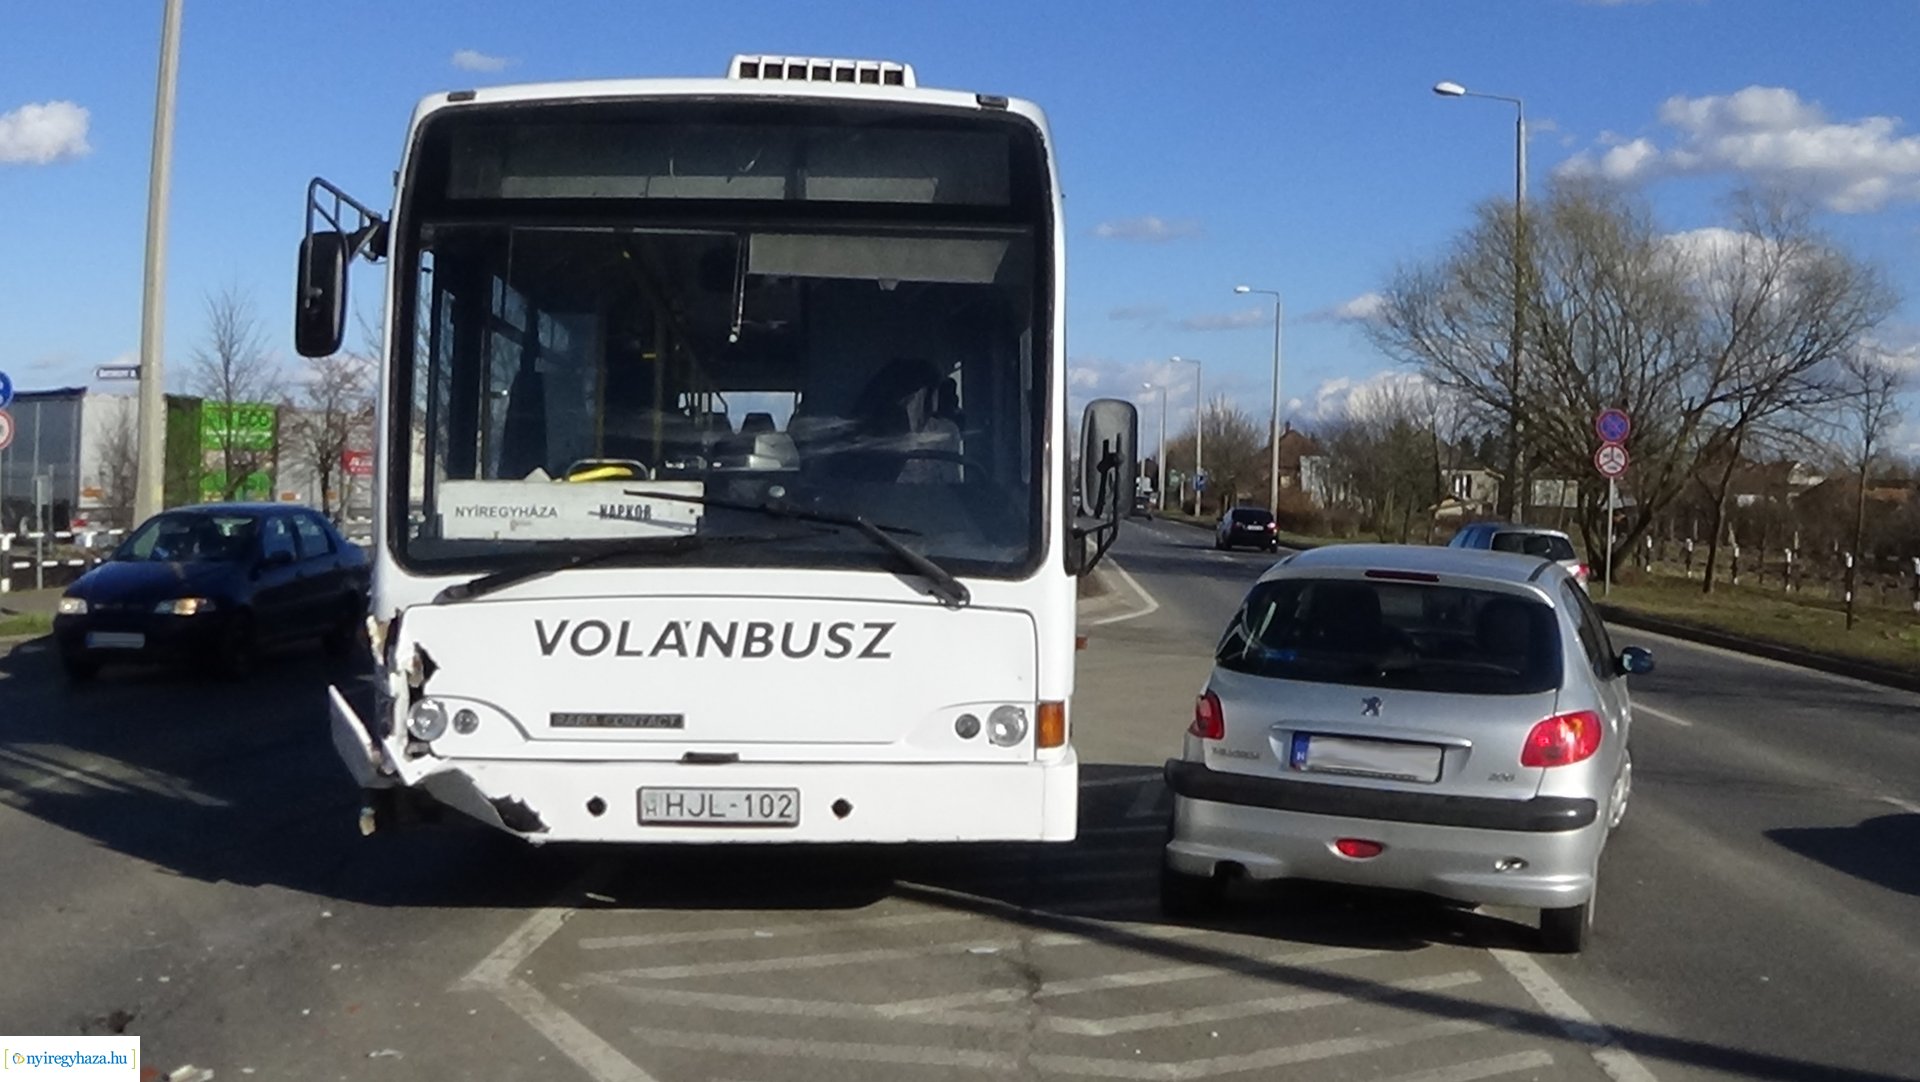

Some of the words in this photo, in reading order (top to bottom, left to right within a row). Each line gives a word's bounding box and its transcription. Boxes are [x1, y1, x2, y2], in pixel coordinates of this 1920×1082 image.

[455, 503, 558, 519] NYÍREGYHÁZA
[534, 619, 897, 660] VOLÁNBUSZ
[666, 793, 792, 818] HJL-102
